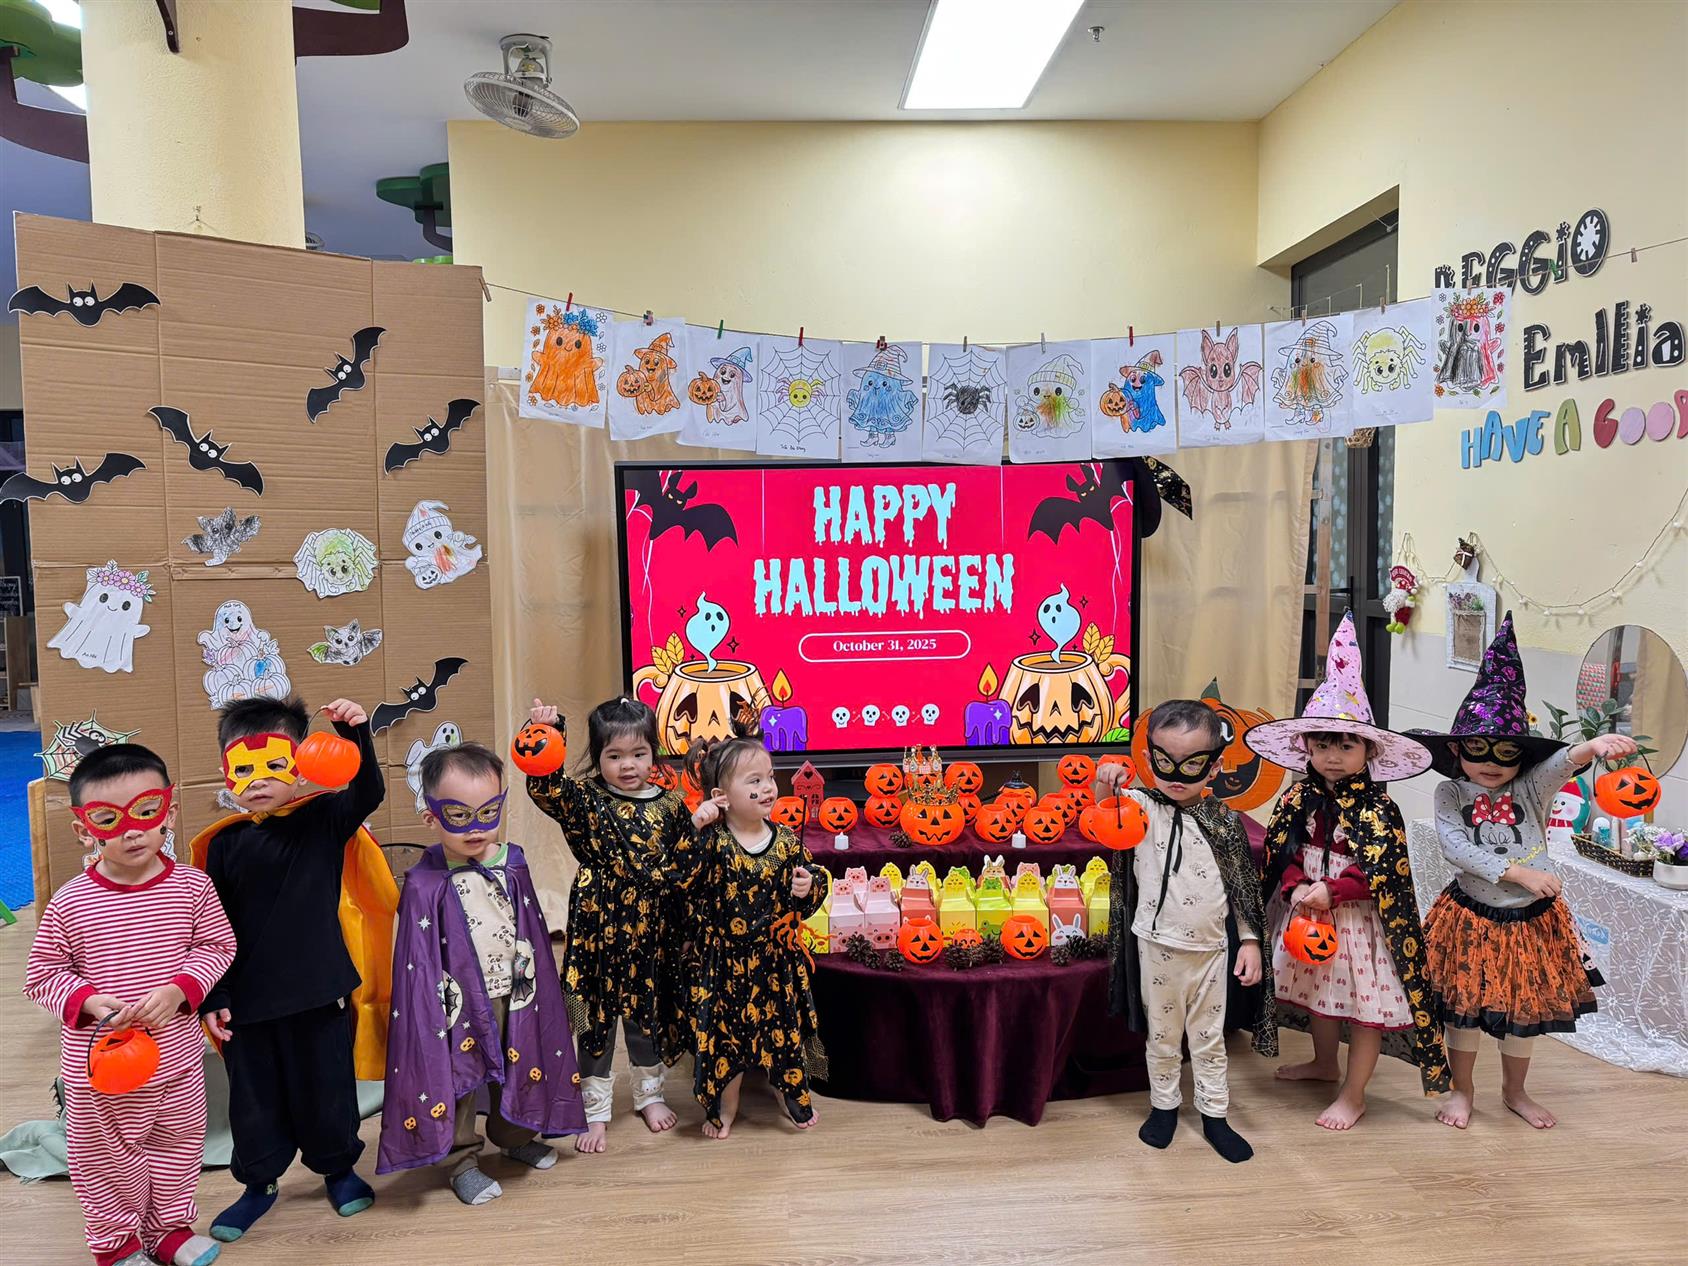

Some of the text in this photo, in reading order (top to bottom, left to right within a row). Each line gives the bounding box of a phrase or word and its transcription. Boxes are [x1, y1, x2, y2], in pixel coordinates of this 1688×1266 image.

[1461, 410, 1550, 469] HAVE
[1554, 398, 1582, 455] A
[813, 482, 956, 549] HAPPY
[753, 553, 1014, 619] HALLOWEEN
[833, 638, 937, 652] October 31, 2025
